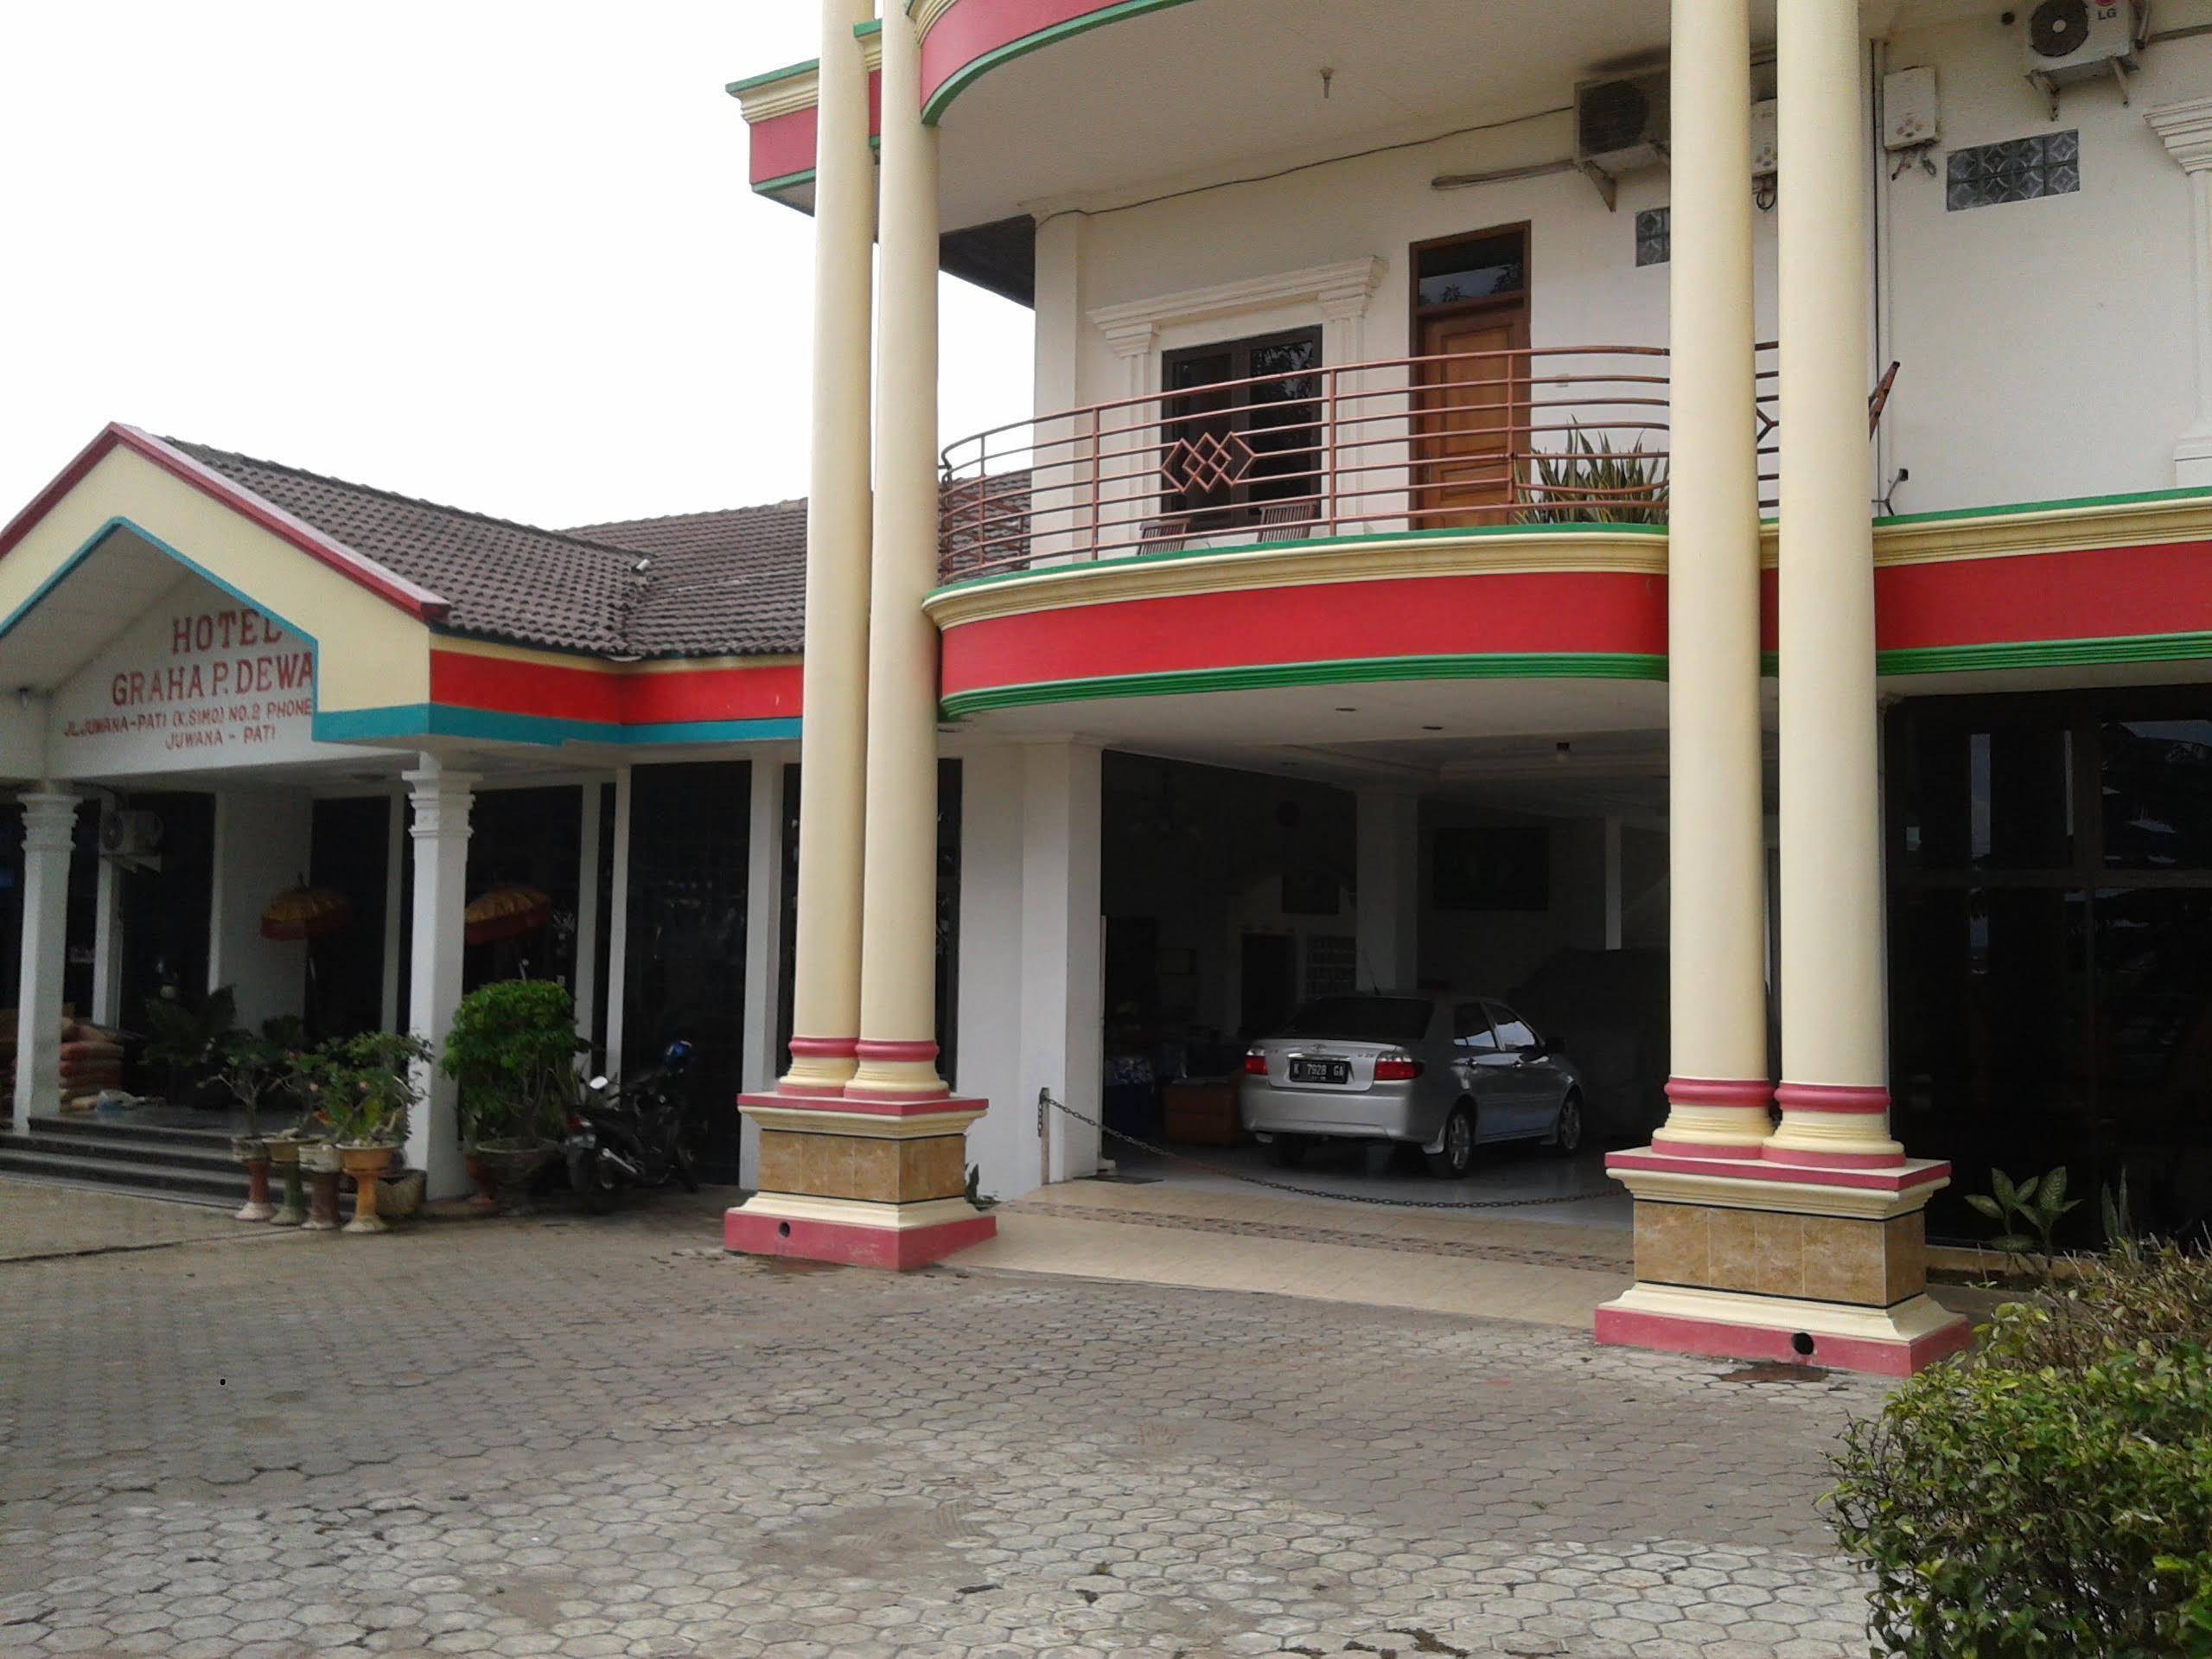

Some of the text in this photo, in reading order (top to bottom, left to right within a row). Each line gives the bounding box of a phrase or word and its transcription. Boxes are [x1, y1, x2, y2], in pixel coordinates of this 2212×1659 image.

[2097, 8, 2117, 20] LG
[172, 609, 283, 654] HOTEL
[112, 665, 204, 706] GRAHA
[235, 652, 312, 694] DEWA
[266, 698, 312, 719] PHONE
[165, 729, 223, 750] JUWANA
[243, 725, 276, 744] PATI
